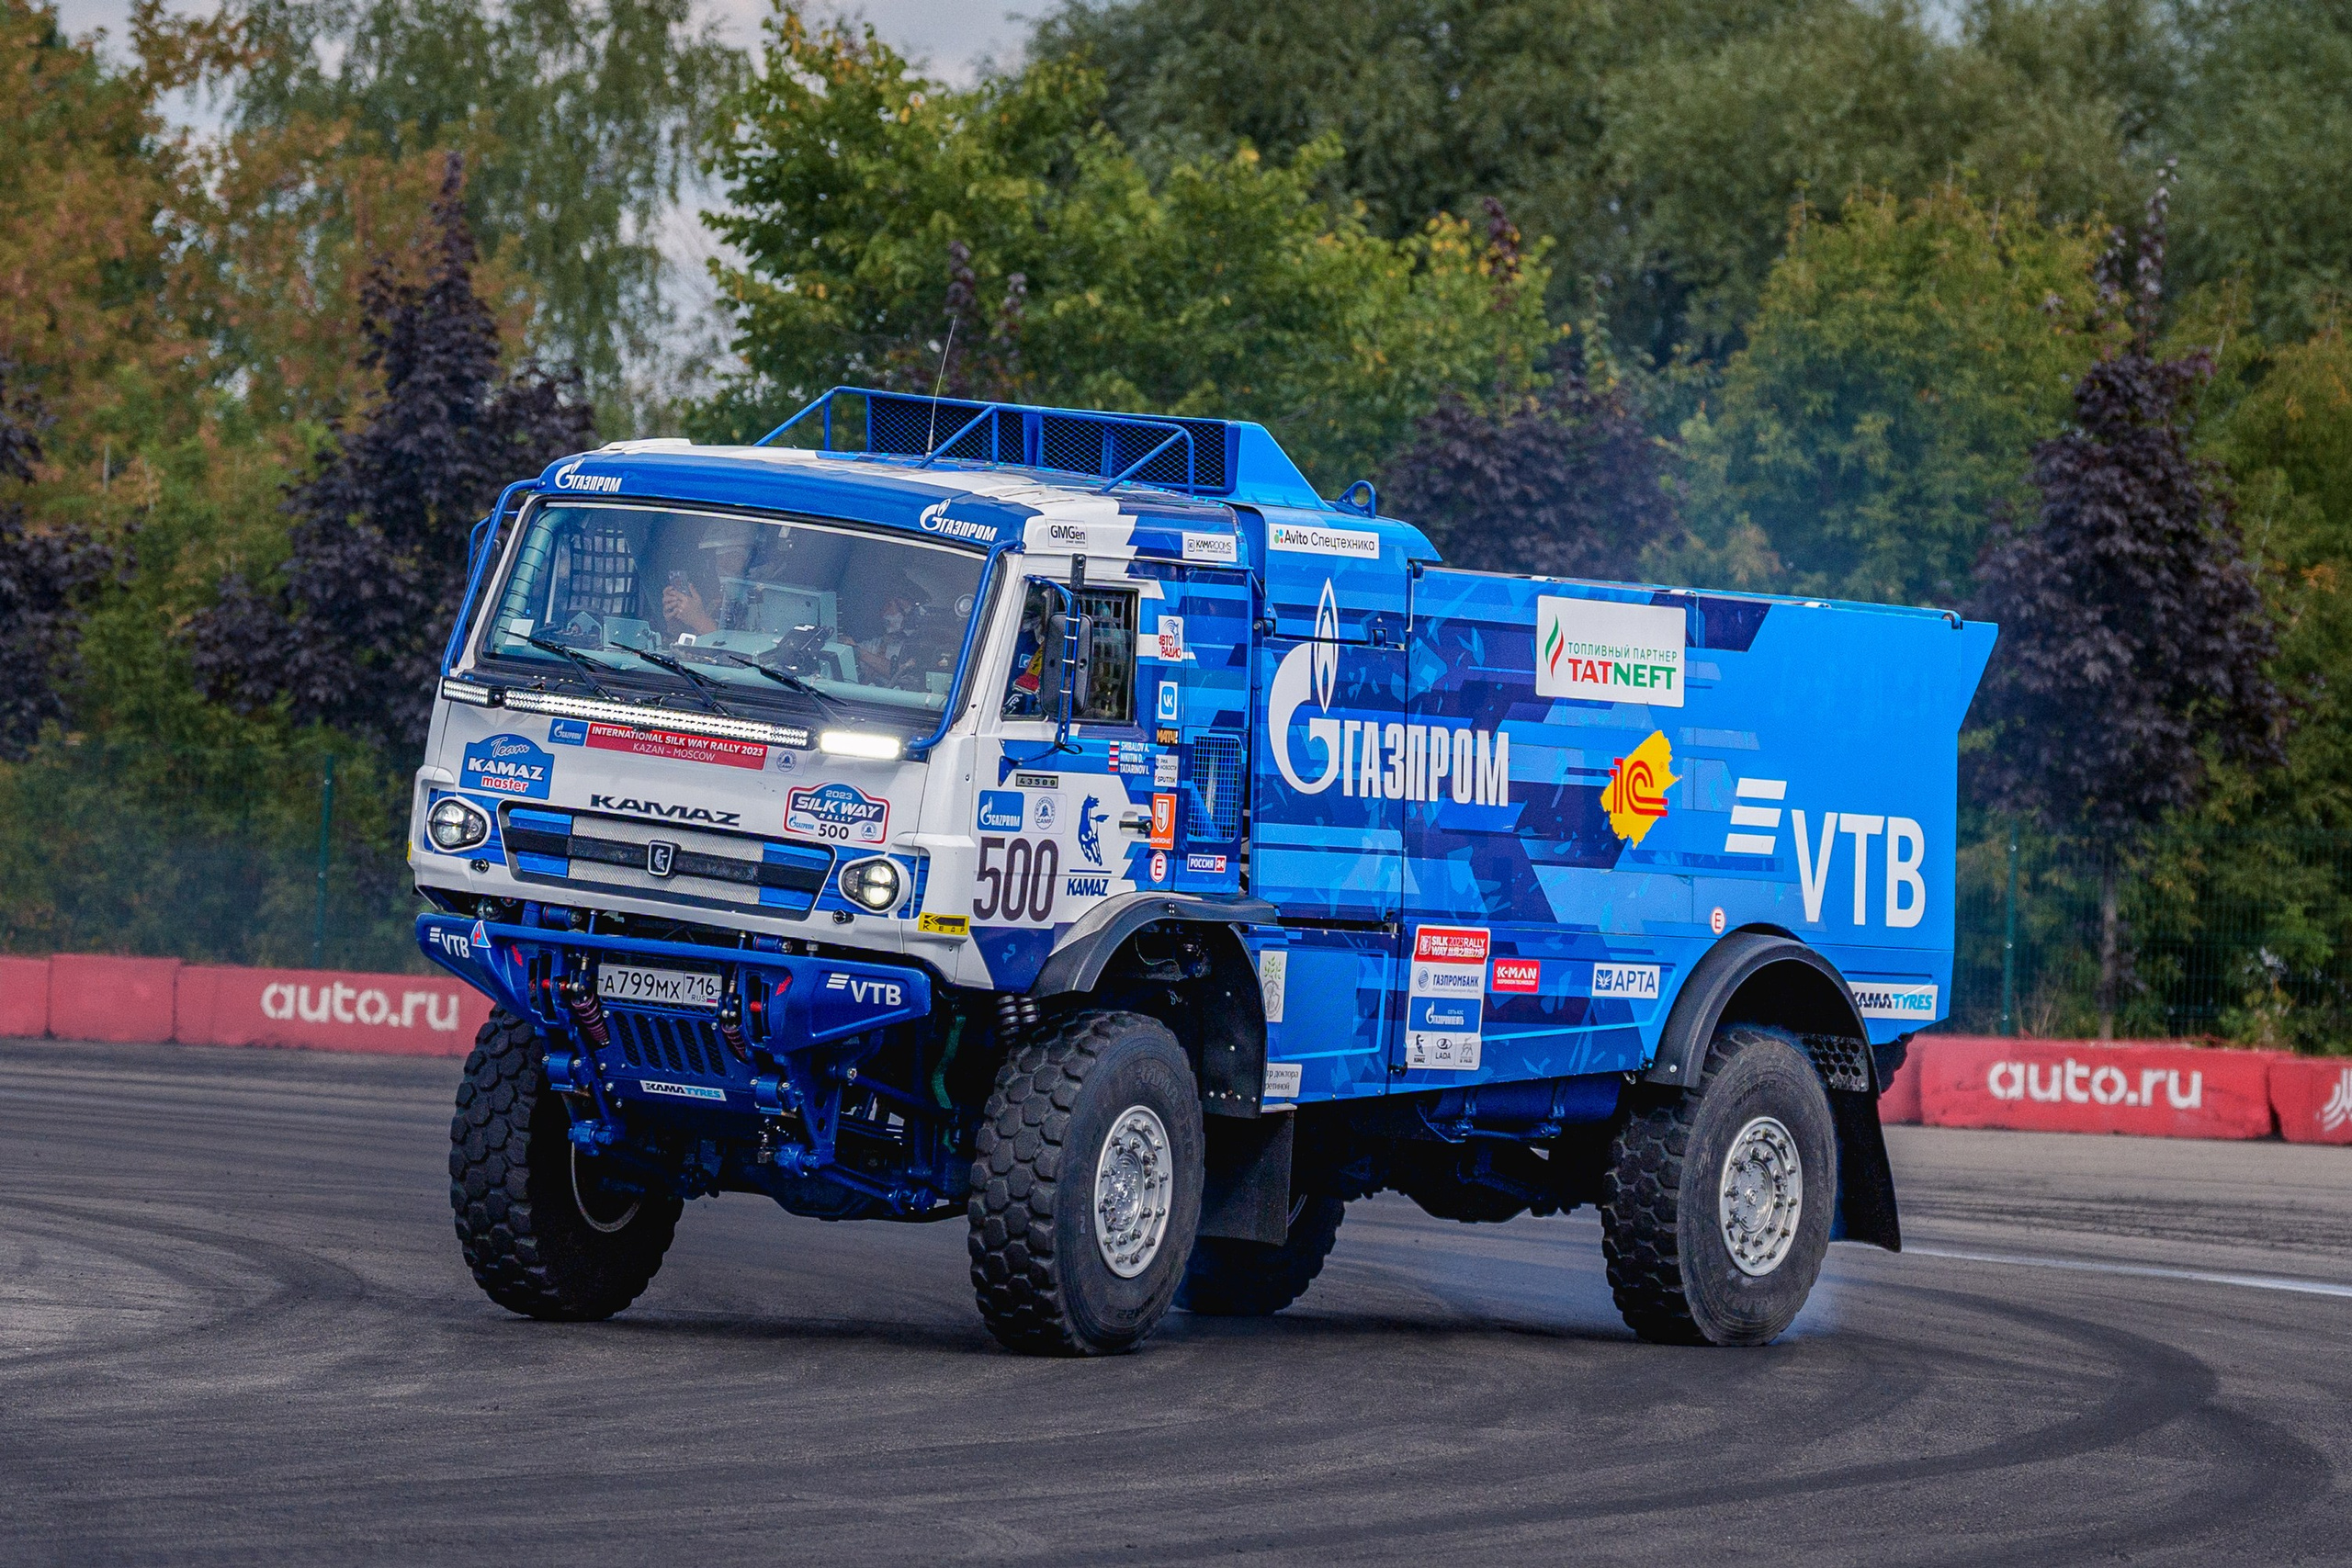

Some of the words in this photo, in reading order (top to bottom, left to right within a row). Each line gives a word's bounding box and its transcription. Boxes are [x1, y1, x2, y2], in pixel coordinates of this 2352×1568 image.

[571, 475, 623, 492] ГАЗПРОМ
[939, 518, 998, 542] ГАЗПРОМ
[1284, 529, 1308, 545] Avito
[1311, 532, 1375, 550] Спецтехника
[1161, 647, 1182, 659] РАДИО
[1567, 642, 1630, 659] ТОПЛИВНЫЙ
[1634, 648, 1678, 662] ПАРТНЕР
[1567, 658, 1677, 690] TATNEFT
[491, 737, 530, 758] Team
[592, 727, 663, 743] INTERNATIONAL
[665, 736, 685, 747] SILK
[687, 739, 709, 750] WAY
[710, 741, 740, 753] RALLY
[741, 745, 763, 756] 2023
[633, 743, 665, 754] KAZAN
[673, 748, 715, 761] MOSCOW
[468, 757, 545, 781] KAMAZ
[1342, 719, 1510, 807] ГАЗПРОМ
[481, 775, 528, 793] master
[825, 790, 853, 800] 2023
[590, 794, 741, 827] KAMAZ
[795, 795, 840, 813] SILK
[841, 802, 881, 818] WAY
[819, 813, 853, 822] RALLY
[818, 823, 850, 840] 500
[1190, 858, 1215, 869] РОССИЯ
[1791, 808, 1926, 928] VTB
[973, 837, 1059, 922] 500
[1067, 878, 1110, 897] KAMAZ
[441, 933, 470, 959] VTB
[1431, 936, 1448, 946] SILK
[1464, 938, 1486, 948] RALLY
[1431, 946, 1447, 955] WAY
[685, 976, 715, 996] 716
[1433, 974, 1479, 987] ГАЗПРОМБАНК
[691, 994, 707, 1003] RUS
[850, 980, 901, 1006] VTB
[260, 980, 460, 1032] auto.ru
[1273, 1071, 1299, 1080] доктора
[1987, 1058, 2203, 1109] auto.ru
